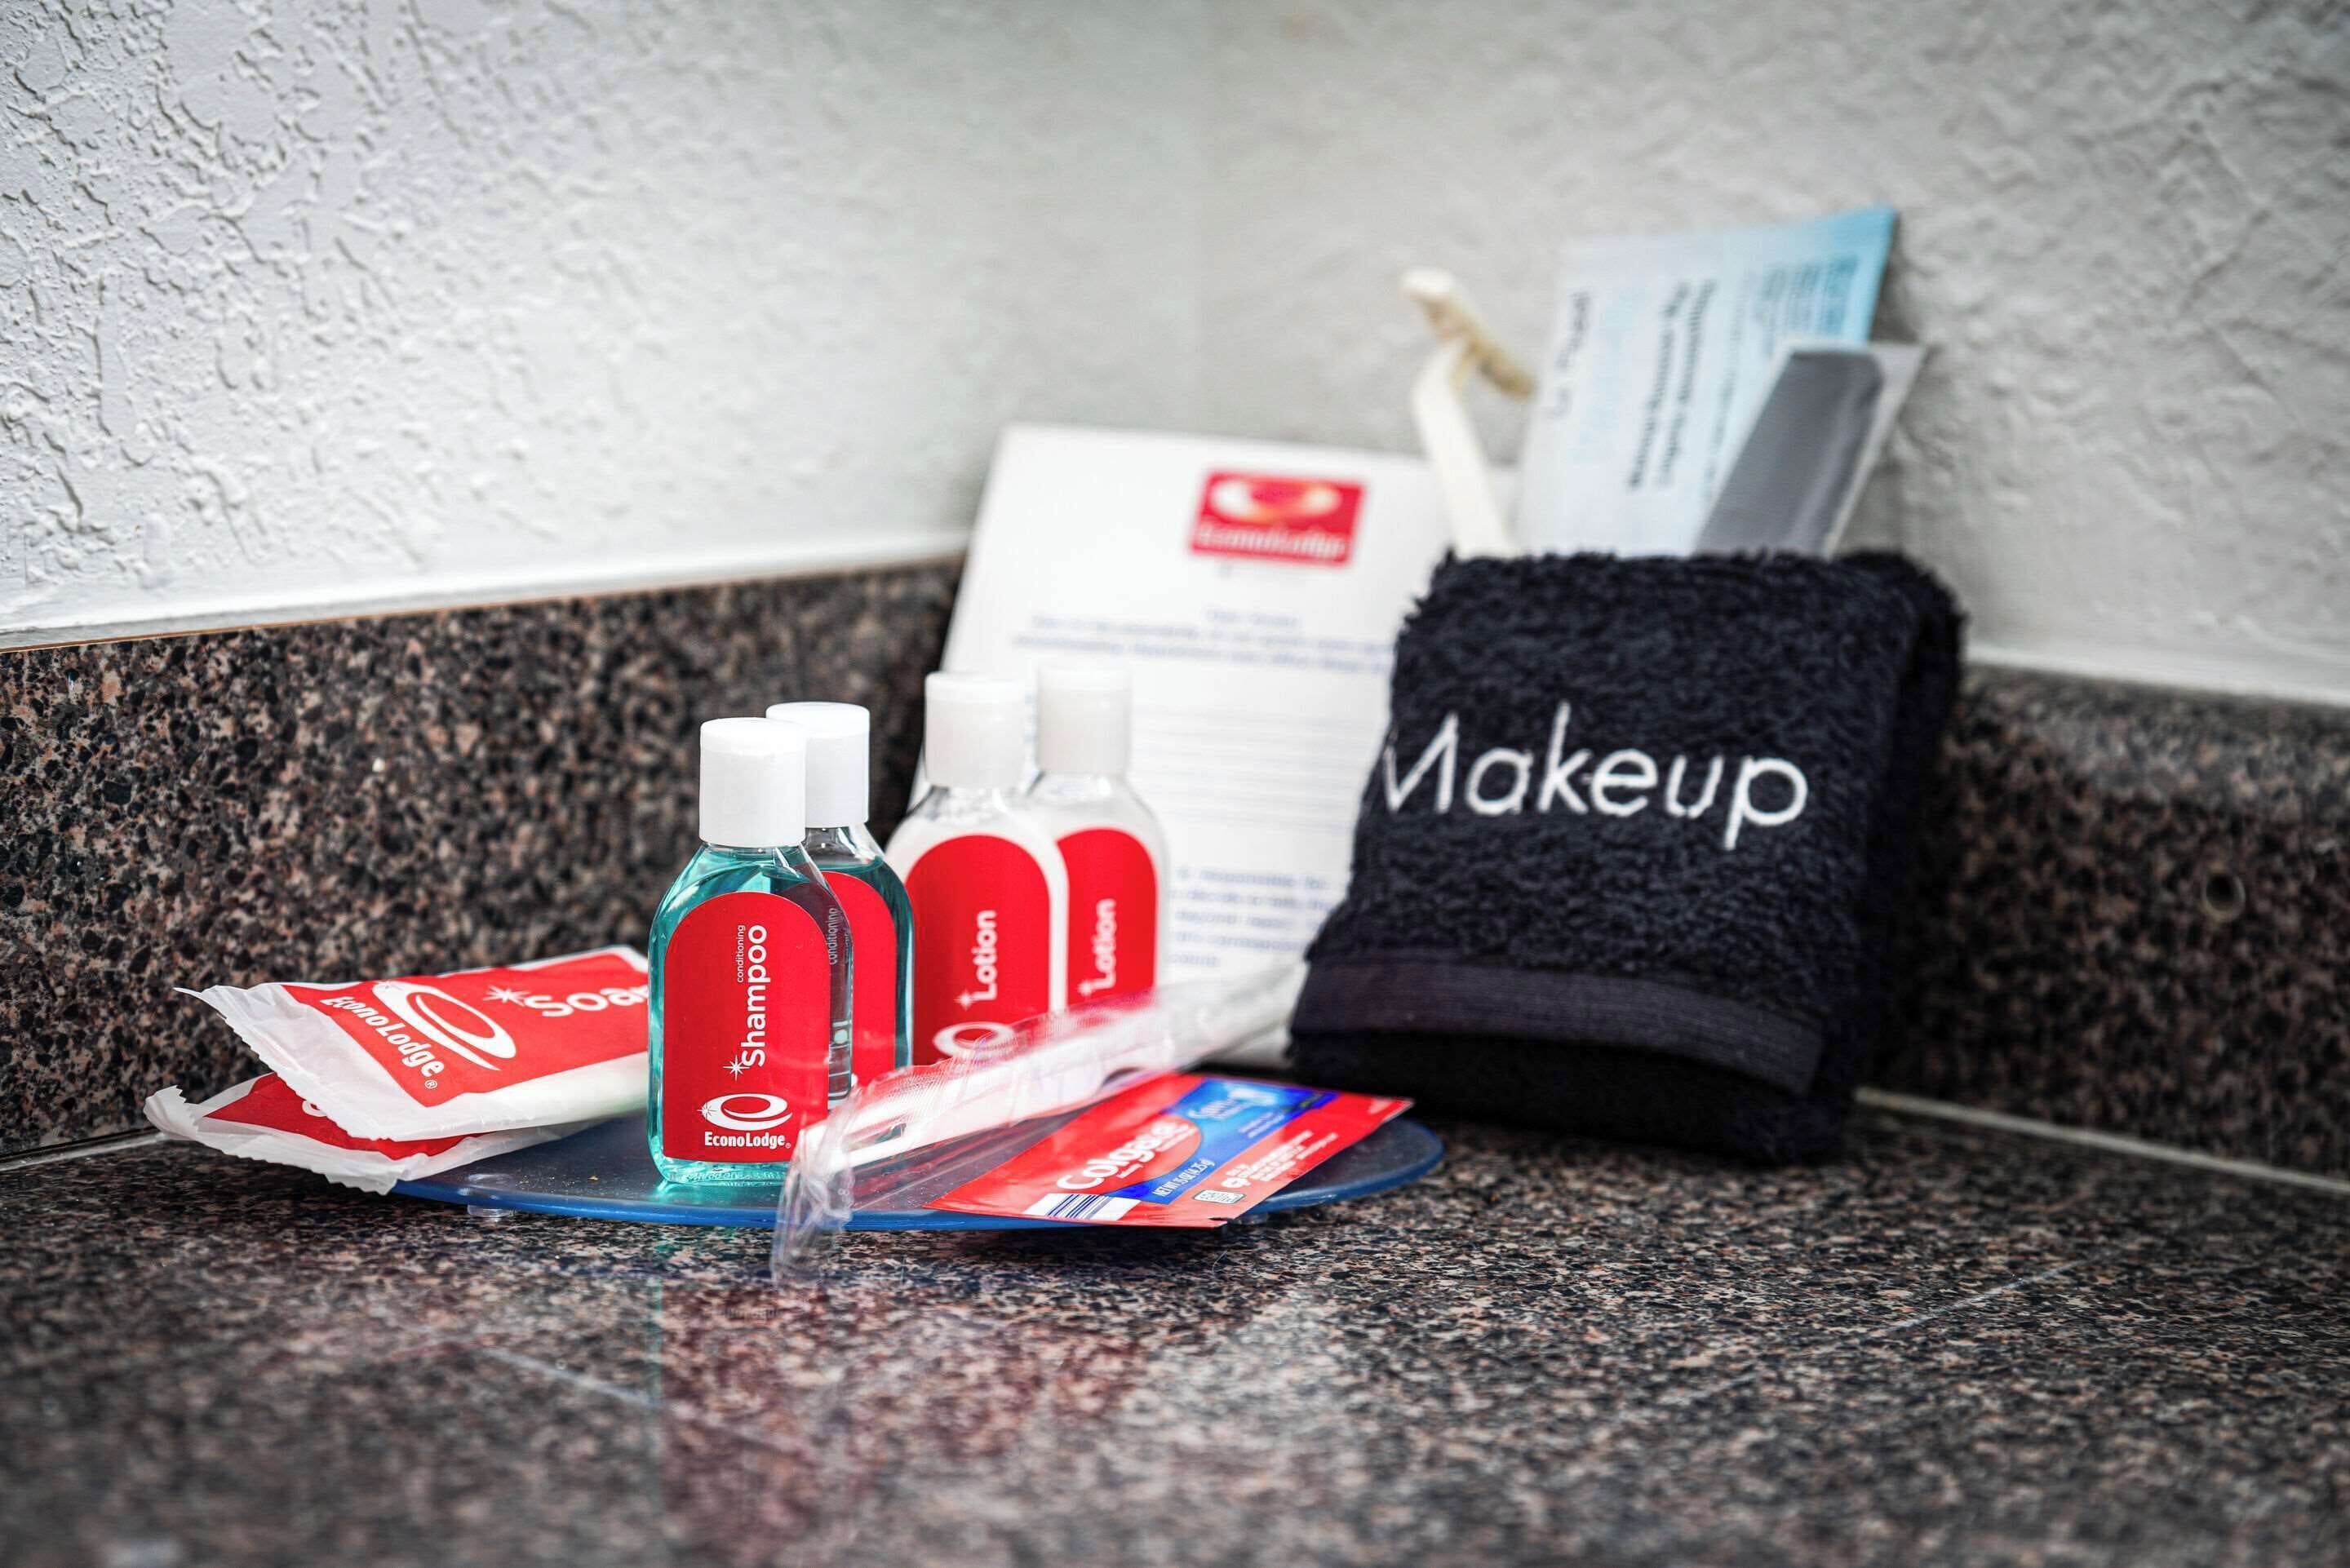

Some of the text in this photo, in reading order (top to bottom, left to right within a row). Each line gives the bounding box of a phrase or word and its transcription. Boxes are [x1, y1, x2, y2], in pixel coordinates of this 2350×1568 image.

[735, 924, 746, 983] conditioning
[971, 910, 998, 1000] Lotion
[1090, 898, 1116, 990] Lotion
[320, 996, 445, 1077] EconoLodge
[741, 924, 771, 1067] Shampoo
[704, 1131, 786, 1149] EconoLodge
